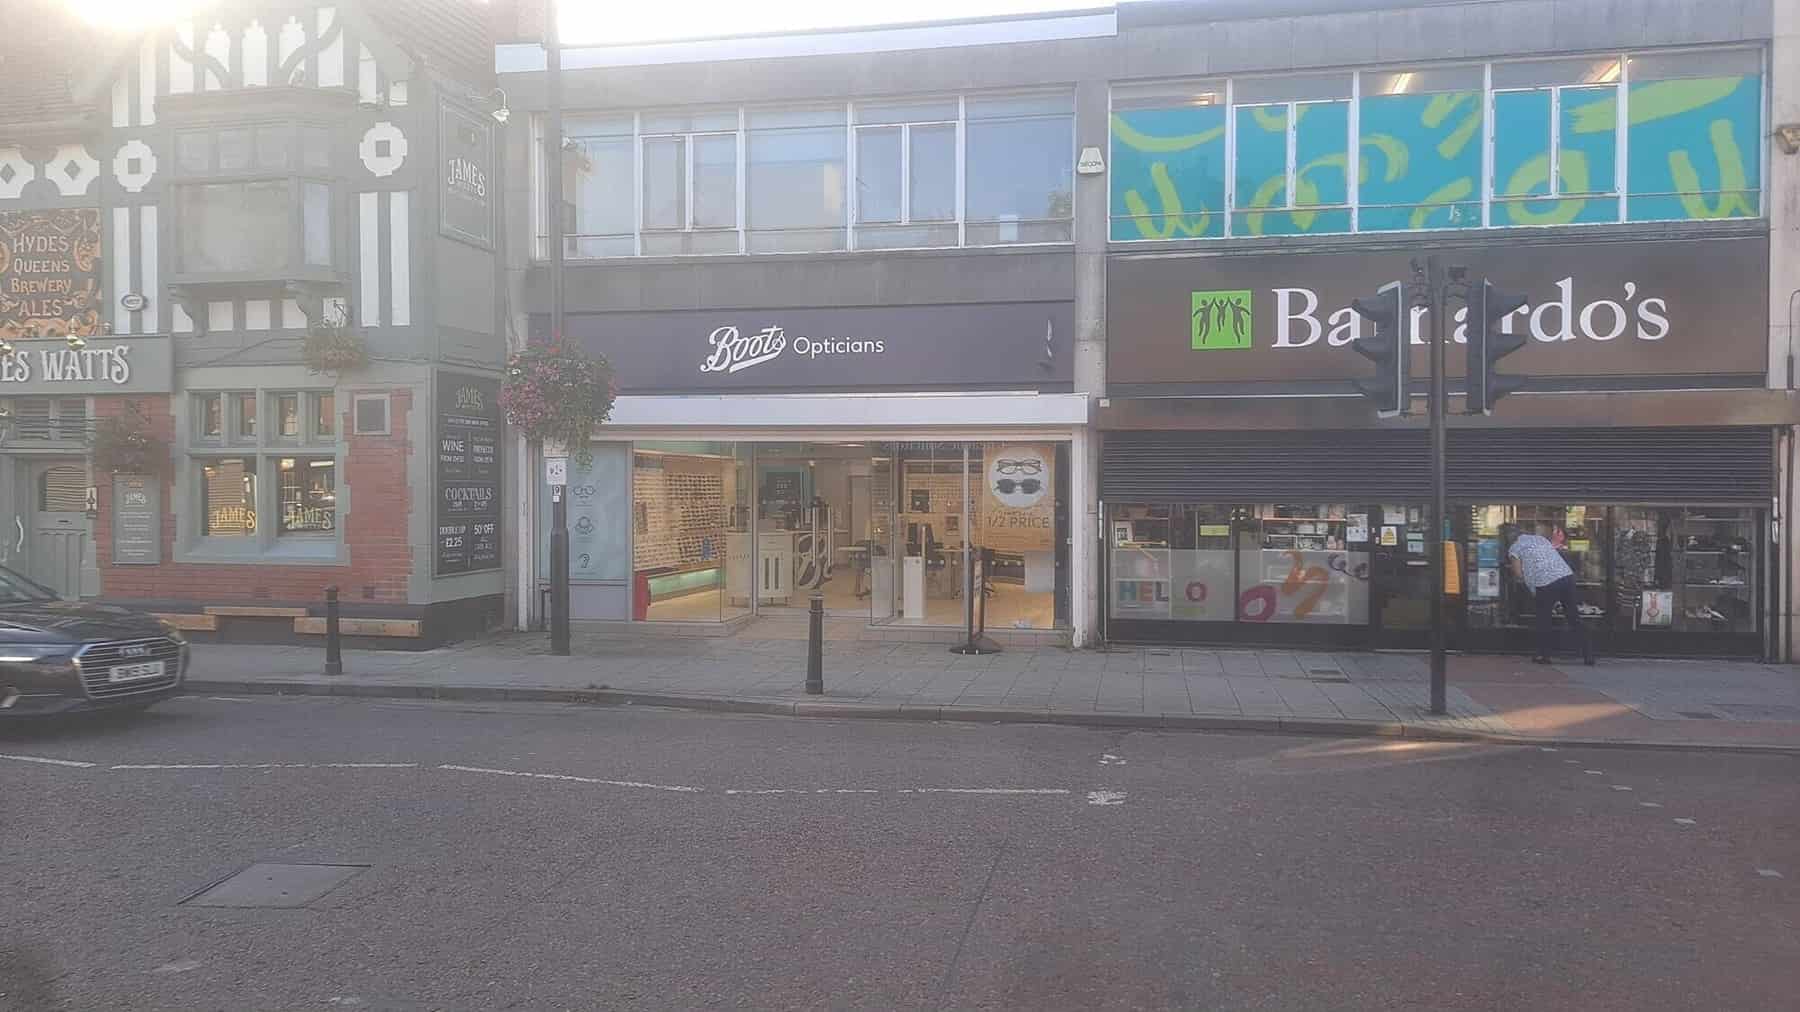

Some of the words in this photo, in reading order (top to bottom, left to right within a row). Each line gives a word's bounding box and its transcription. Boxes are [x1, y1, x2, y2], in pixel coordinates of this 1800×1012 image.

[447, 157, 486, 197] JAMES
[13, 233, 70, 254] HYDES
[14, 258, 70, 276] QUEENS
[10, 277, 72, 296] BREWERY
[18, 299, 64, 317] ALES
[1272, 276, 1670, 350] Banardo's
[700, 325, 787, 373] Boots
[793, 336, 885, 359] Opticians
[40, 345, 129, 384] WATTS
[441, 439, 465, 453] WINE
[445, 487, 492, 501] COCKTAILS
[213, 504, 257, 529] JAMES
[285, 506, 333, 530] JAMES
[1010, 516, 1049, 528] PRICE
